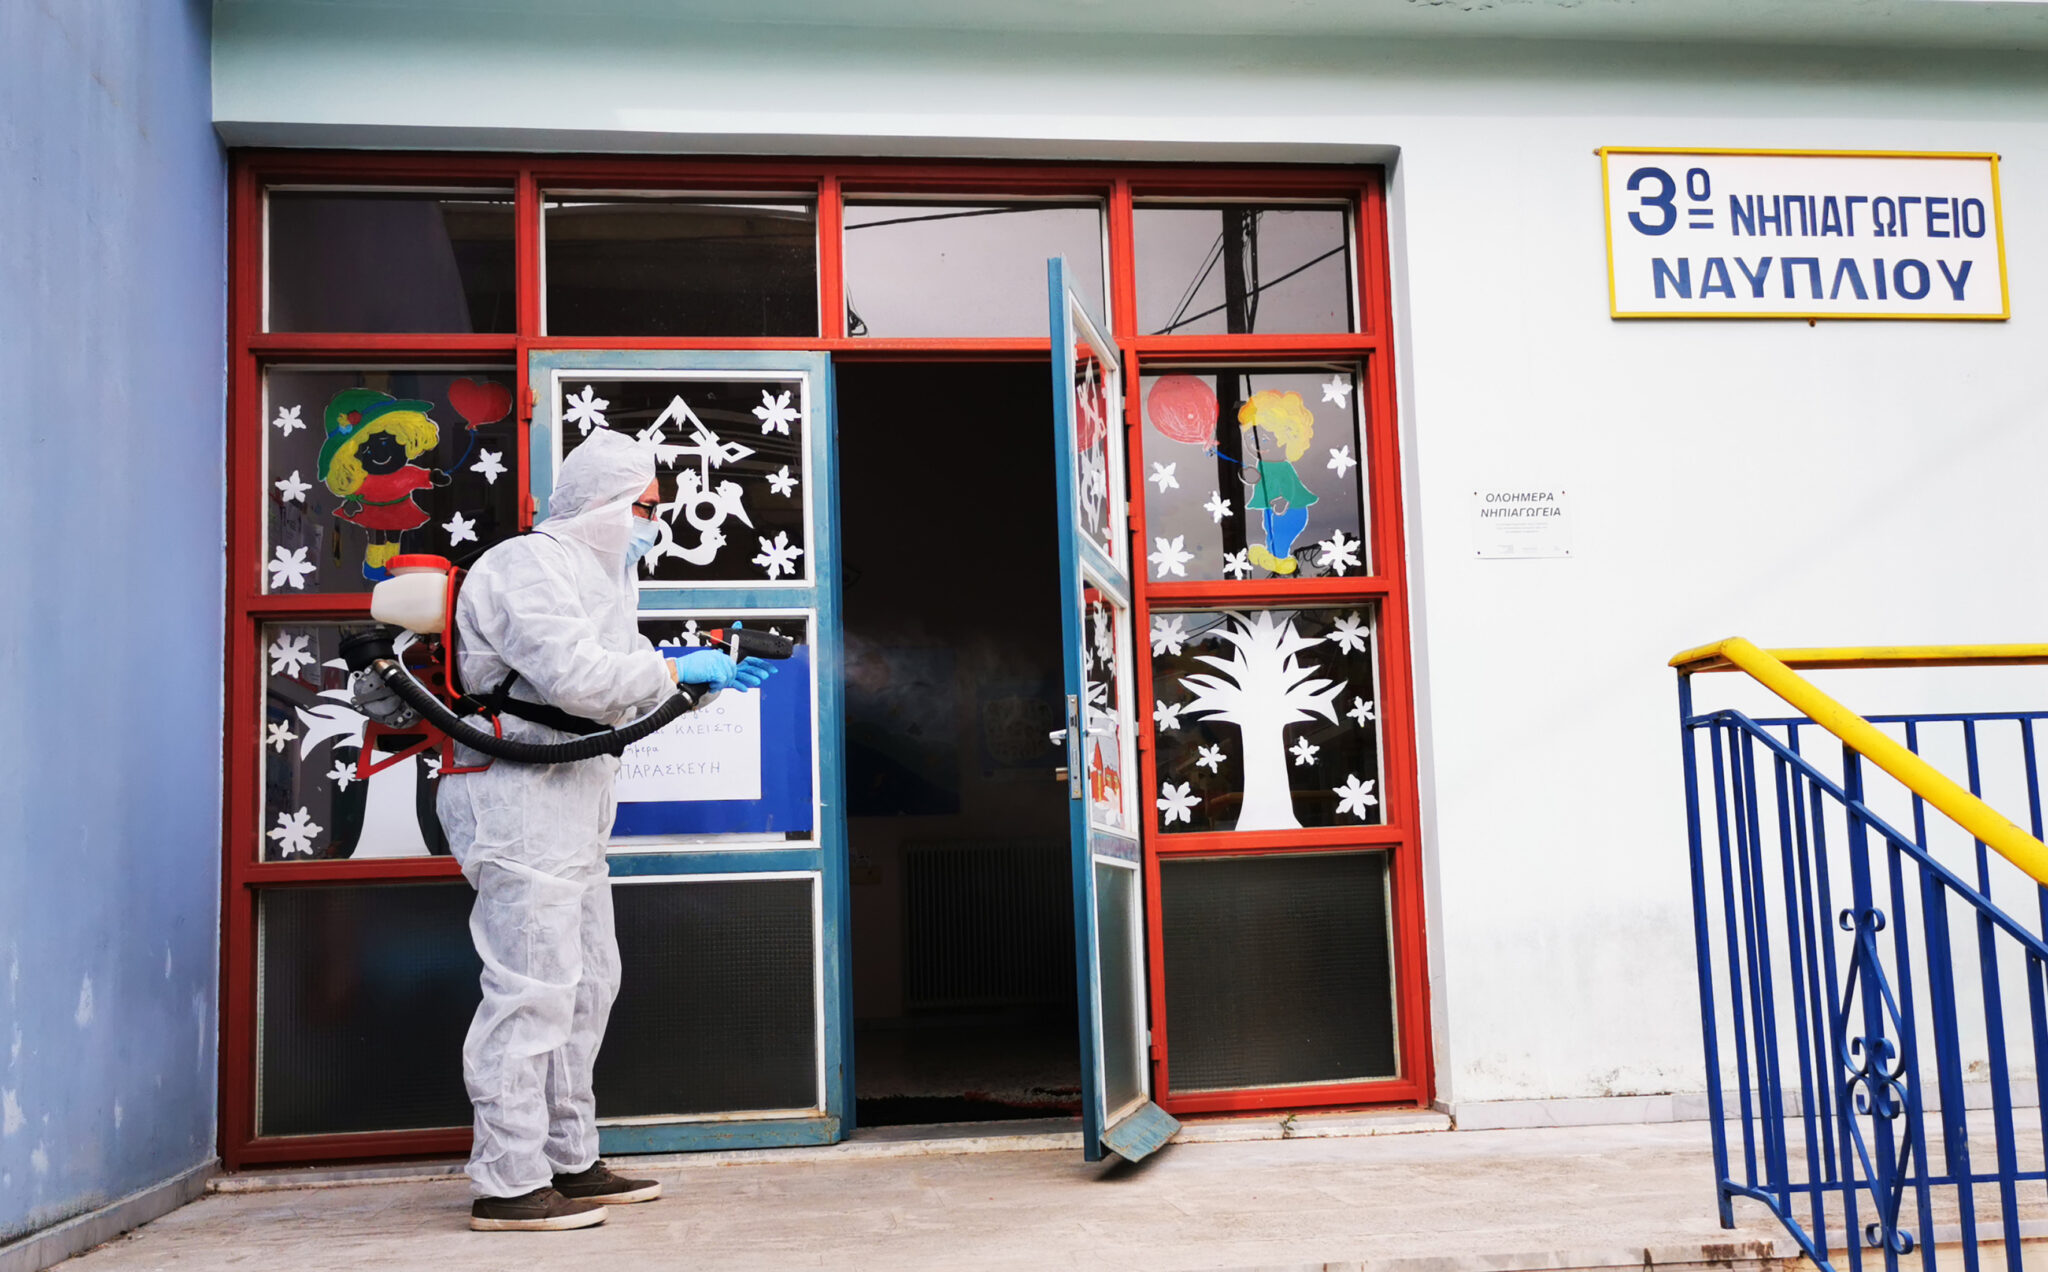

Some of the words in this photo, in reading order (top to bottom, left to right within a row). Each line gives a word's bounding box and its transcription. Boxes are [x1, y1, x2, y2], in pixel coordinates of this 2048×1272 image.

[1729, 194, 1986, 238] ΝΗΠΙΑΓΩΓΕΙΟ
[1651, 256, 1973, 301] ΝΑΥΠΛΙΟΥ
[1485, 492, 1554, 503] ΟΛΟΗΜΕΡΑ
[1480, 507, 1561, 518] ΝΗΠΙΑΓΩΓΕΙΑ
[675, 723, 743, 735] ΚΛΕΙΣΤΟ
[624, 744, 659, 758] ημερα
[618, 761, 721, 780] ΠΑΡΑΣΚΕΥΗ
